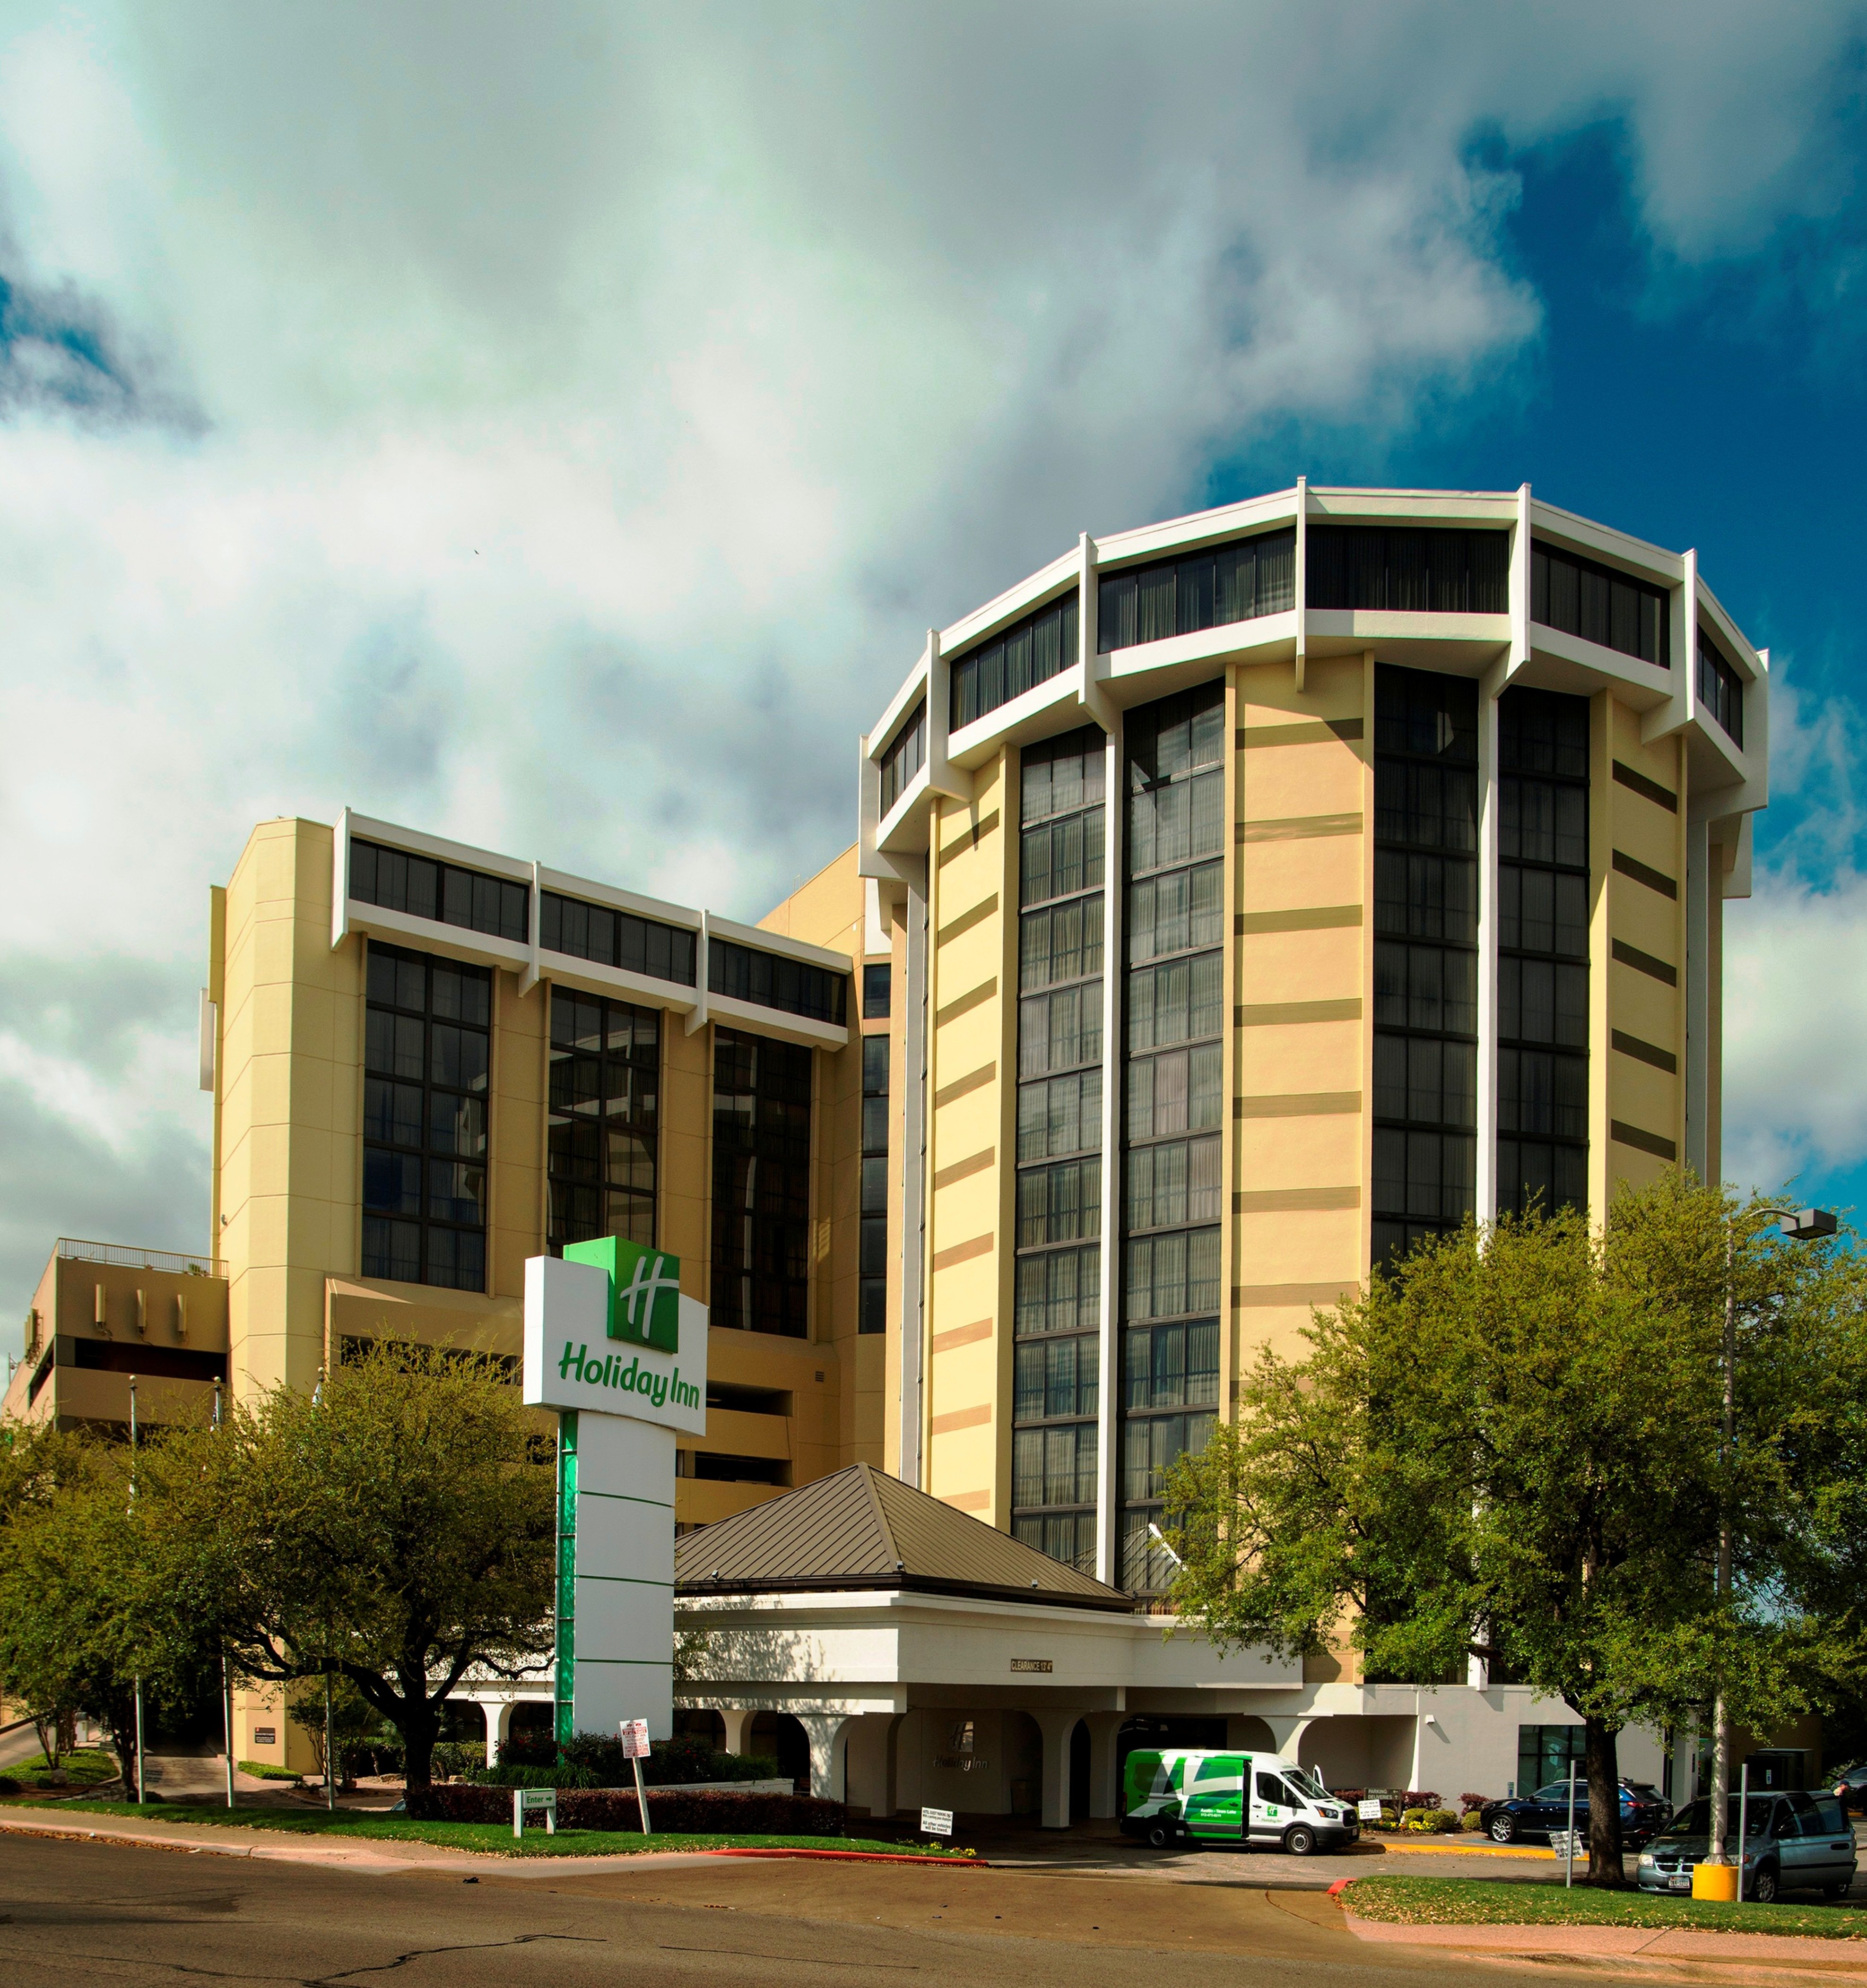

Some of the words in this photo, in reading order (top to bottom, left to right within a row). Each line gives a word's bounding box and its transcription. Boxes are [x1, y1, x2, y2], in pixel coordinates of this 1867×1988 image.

[558, 1341, 668, 1408] Holiday
[670, 1367, 700, 1410] Inn
[1011, 1660, 1040, 1671] CLEARANCE
[933, 1755, 971, 1771] Holiday
[972, 1756, 988, 1769] Inn
